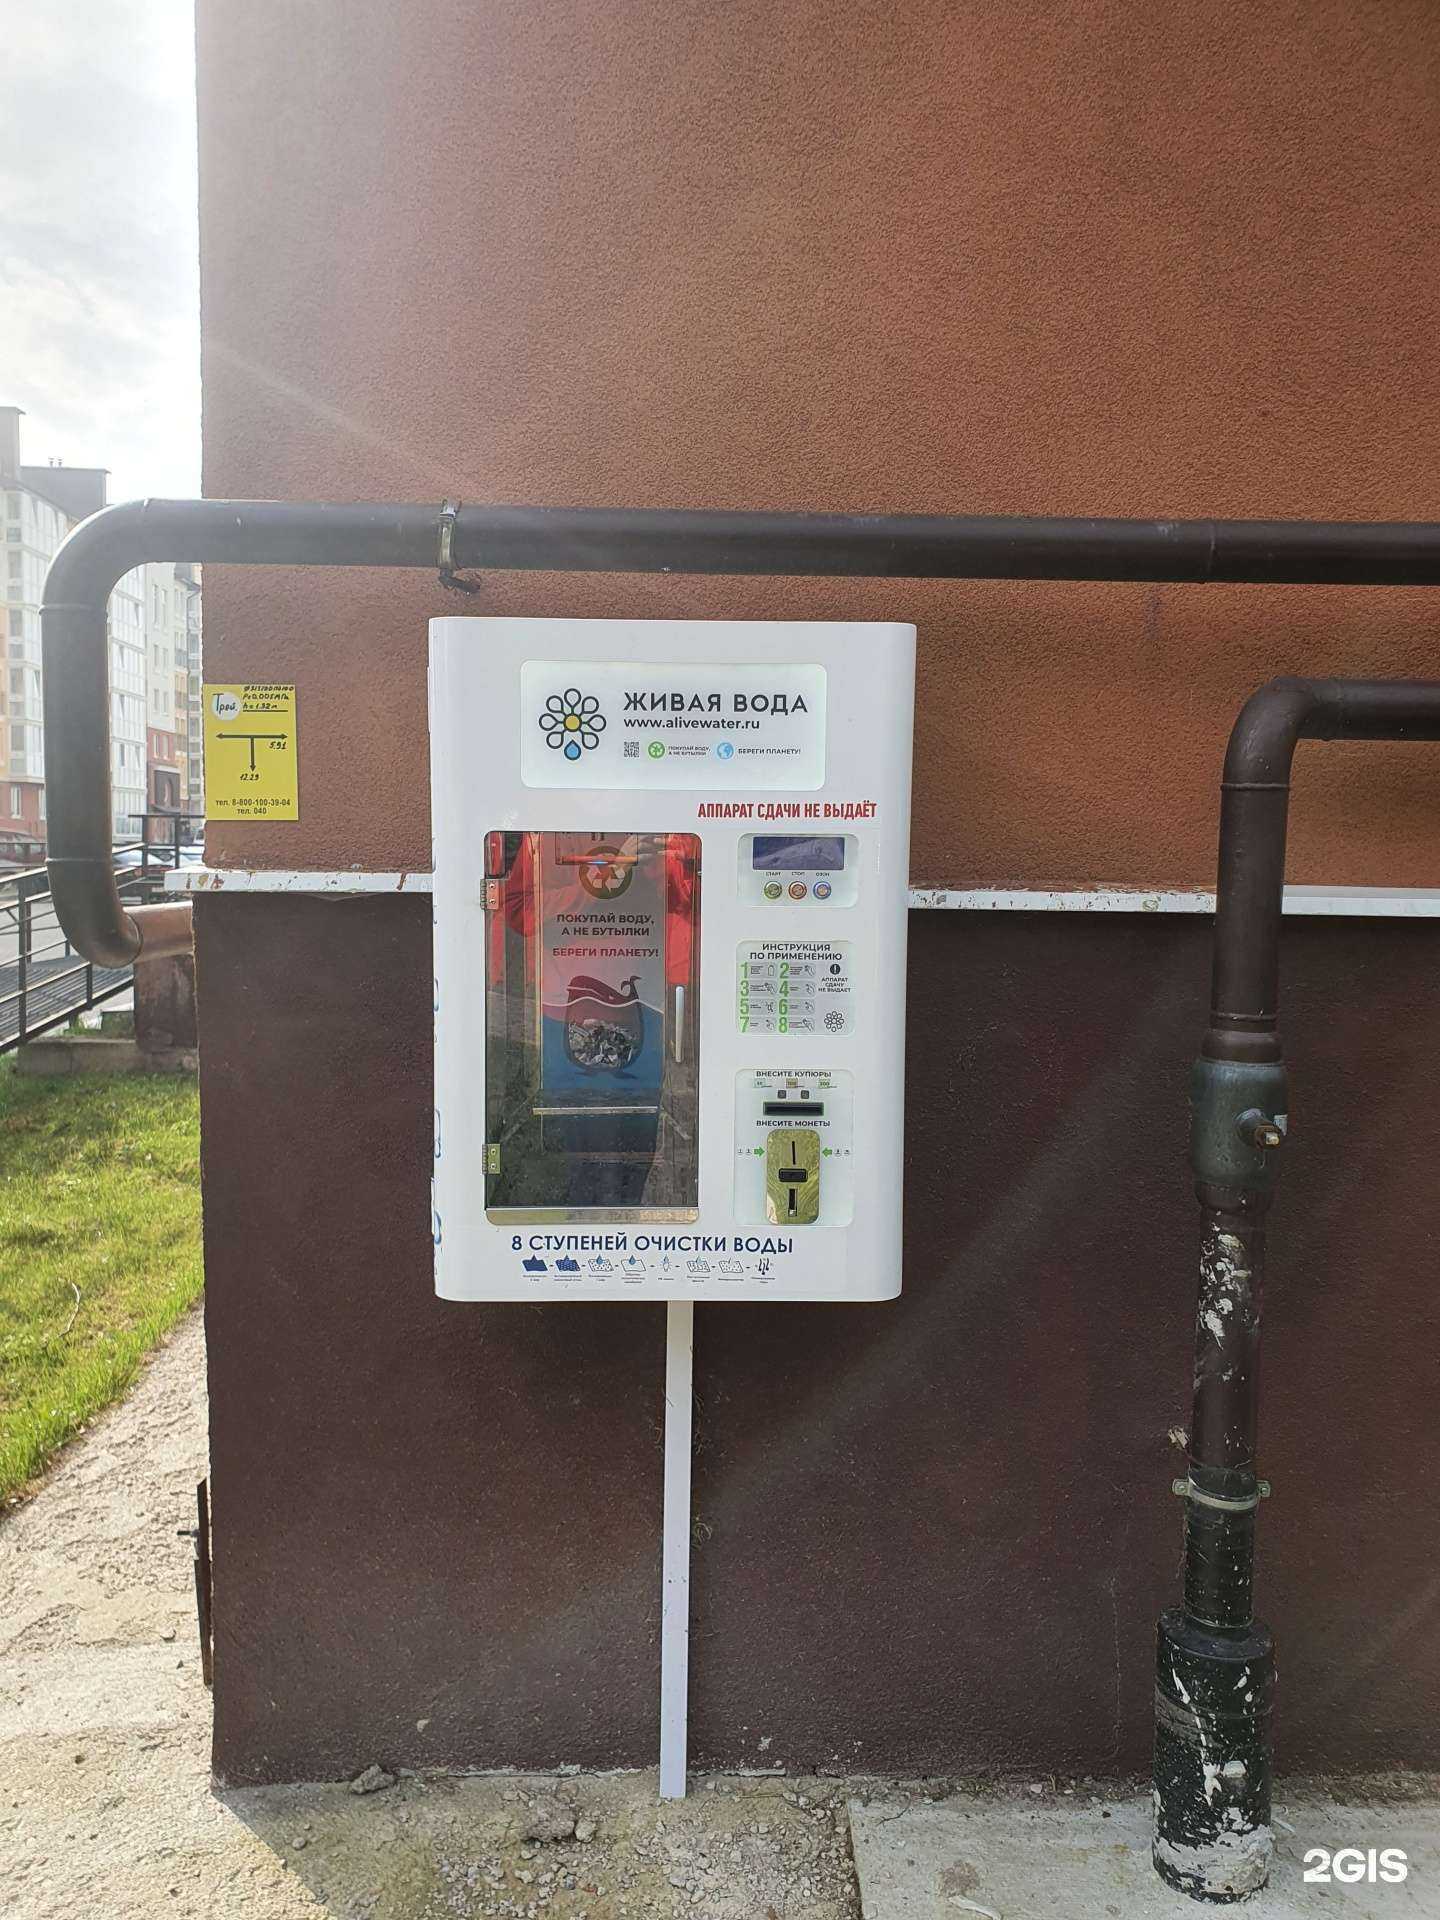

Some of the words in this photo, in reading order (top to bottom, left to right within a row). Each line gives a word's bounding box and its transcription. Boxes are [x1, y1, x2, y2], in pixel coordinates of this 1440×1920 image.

[623, 692, 721, 712] ЖИВАЯ
[733, 694, 808, 716] ВОДА
[624, 717, 760, 729] www.alivewater.ru
[697, 803, 754, 818] АППАРАТ
[757, 803, 800, 820] СДАЧИ
[804, 803, 821, 818] НЕ
[823, 800, 877, 820] ВЫДАЁТ
[556, 912, 616, 924] ПОКУПАЙ
[618, 914, 655, 925] ВОДУ,
[561, 927, 571, 936] А
[573, 927, 589, 936] НЕ
[592, 927, 650, 936] БУТЫЛКИ
[552, 948, 597, 957] БЕРЕГИ
[600, 948, 659, 957] ПЛАНЕТУ!
[762, 943, 831, 952] ИНСТРУКЦИЯ
[750, 952, 765, 960] ПО
[767, 952, 842, 961] ПРИМЕНЕНИЮ
[740, 962, 748, 978] 1
[780, 962, 789, 979] 2
[740, 980, 749, 997] 3
[779, 980, 789, 997] 4
[740, 998, 749, 1015] 5
[779, 998, 788, 1015] 6
[740, 1017, 749, 1033] 7
[778, 1017, 788, 1034] 8
[511, 1235, 523, 1251] 8
[529, 1232, 627, 1251] СТУПЕНЕЙ
[634, 1236, 726, 1252] ОЧИСТКИ
[733, 1237, 793, 1254] ВОДЫ
